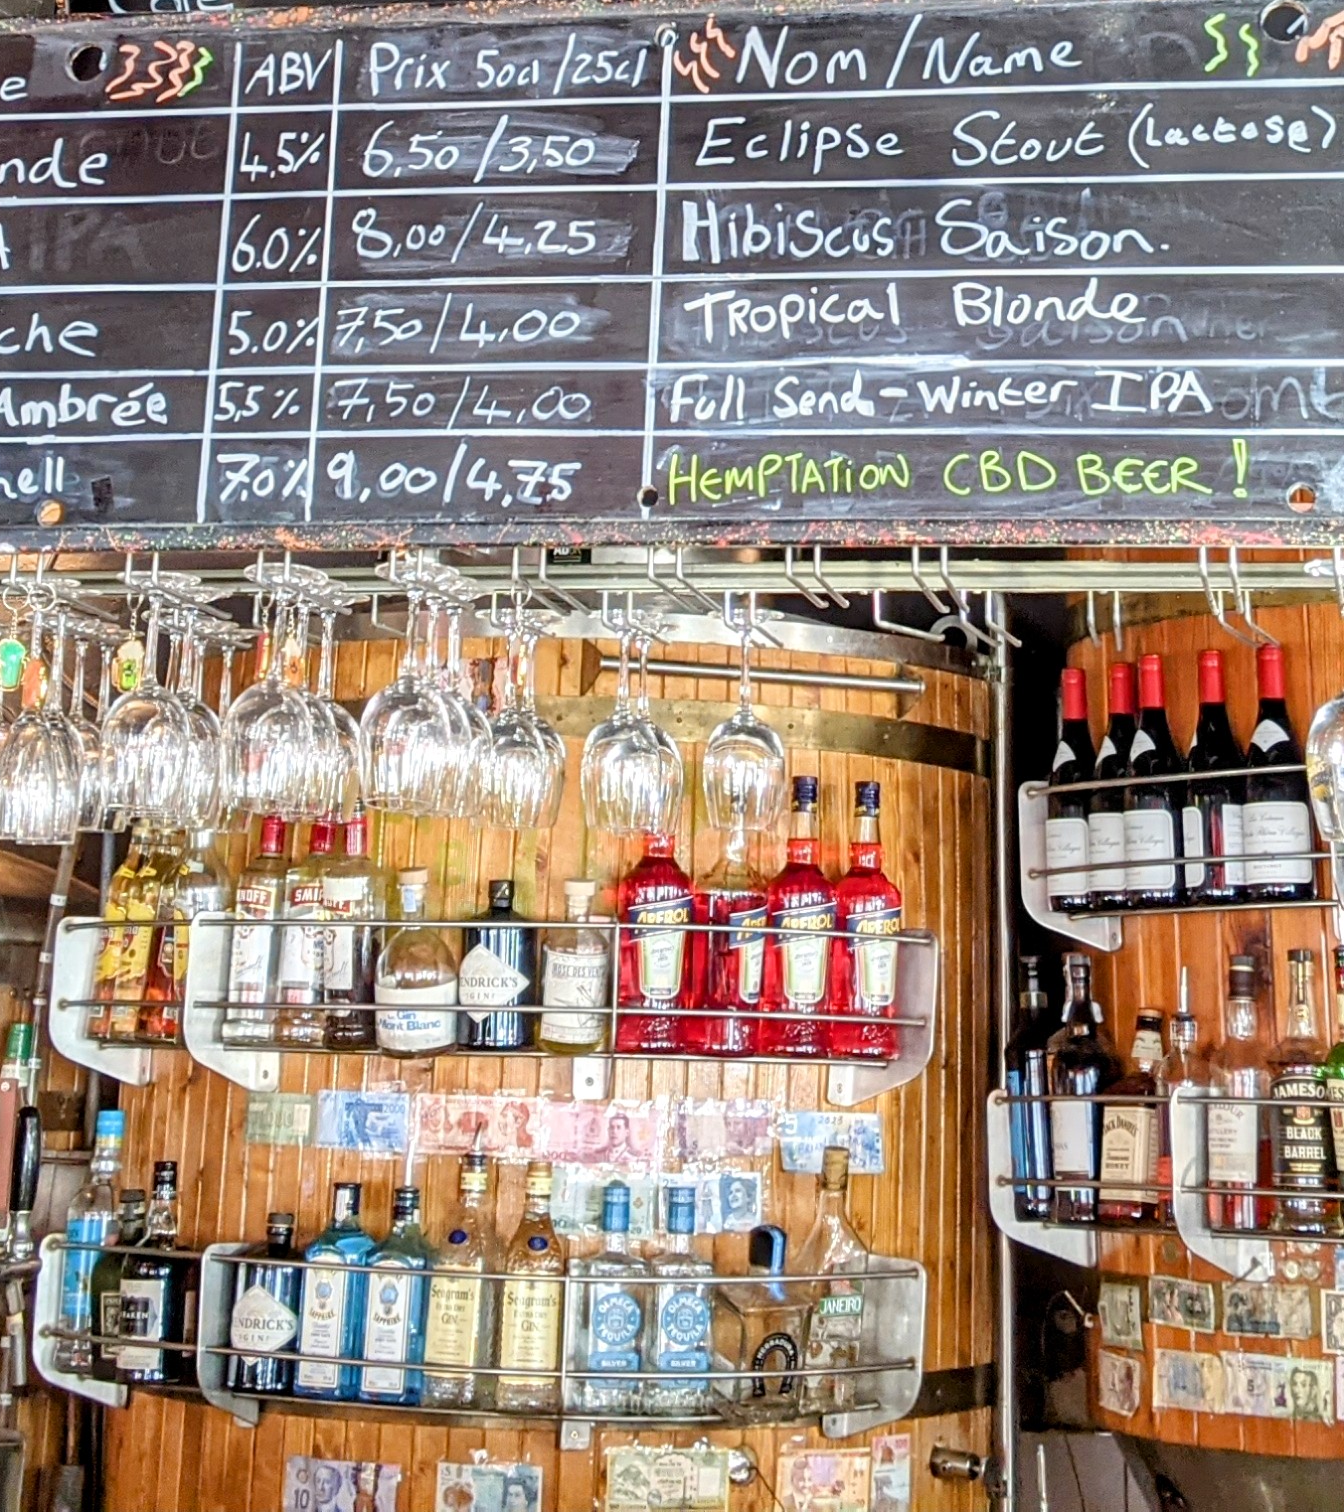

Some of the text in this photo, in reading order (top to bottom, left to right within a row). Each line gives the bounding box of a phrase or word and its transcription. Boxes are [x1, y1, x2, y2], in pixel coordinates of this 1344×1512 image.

[245, 48, 333, 94] ABV
[368, 40, 447, 98] Prix
[694, 116, 906, 175] Eclipse
[952, 109, 1106, 169] Stout
[952, 278, 1148, 327] Blonde
[670, 372, 746, 423] Full
[1090, 371, 1214, 414] IPA
[944, 450, 1056, 496] CBD
[406, 1018, 442, 1032] Blanc
[1273, 1081, 1326, 1099] JAMESO
[1286, 1126, 1323, 1140] BLACK
[1284, 1144, 1327, 1160] BARREL
[430, 1284, 476, 1302] Seagram's
[507, 1293, 557, 1308] Seagram's
[598, 1292, 634, 1315] OLMECA
[668, 1292, 704, 1315] OLMECA
[819, 1297, 862, 1316] JANEIRO
[596, 1322, 638, 1341] TEQUILA
[666, 1322, 706, 1341] TEQUILA
[294, 1488, 310, 1510] 10
